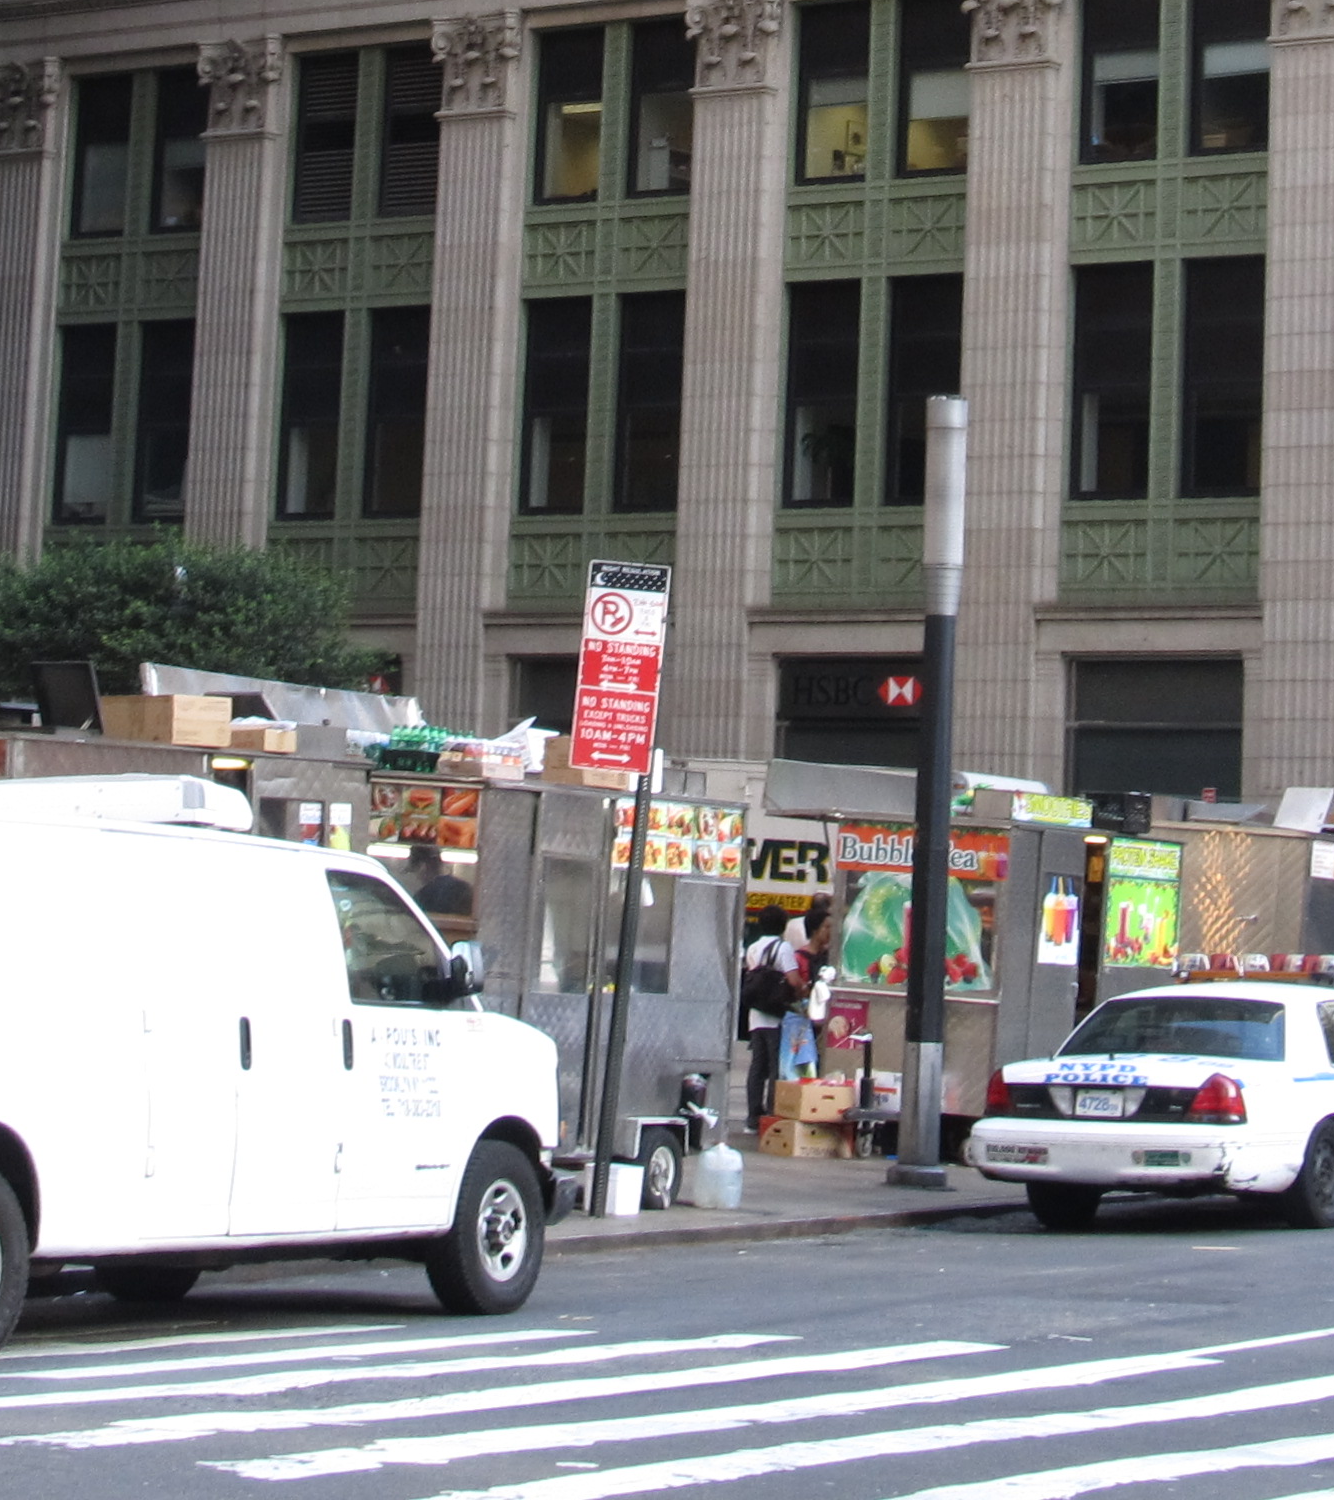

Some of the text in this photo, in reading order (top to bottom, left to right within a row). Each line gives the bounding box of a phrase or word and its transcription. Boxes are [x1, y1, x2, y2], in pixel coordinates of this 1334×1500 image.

[587, 641, 657, 658] NO STANDING
[793, 675, 874, 706] HSBC
[582, 696, 651, 713] NO STANDING
[582, 710, 613, 720] EXCEPT
[579, 728, 646, 745] 10AM-4PM
[839, 833, 979, 872] Bubbl ea
[1058, 1063, 1137, 1073] NYPD
[1043, 1073, 1149, 1086] POLICE
